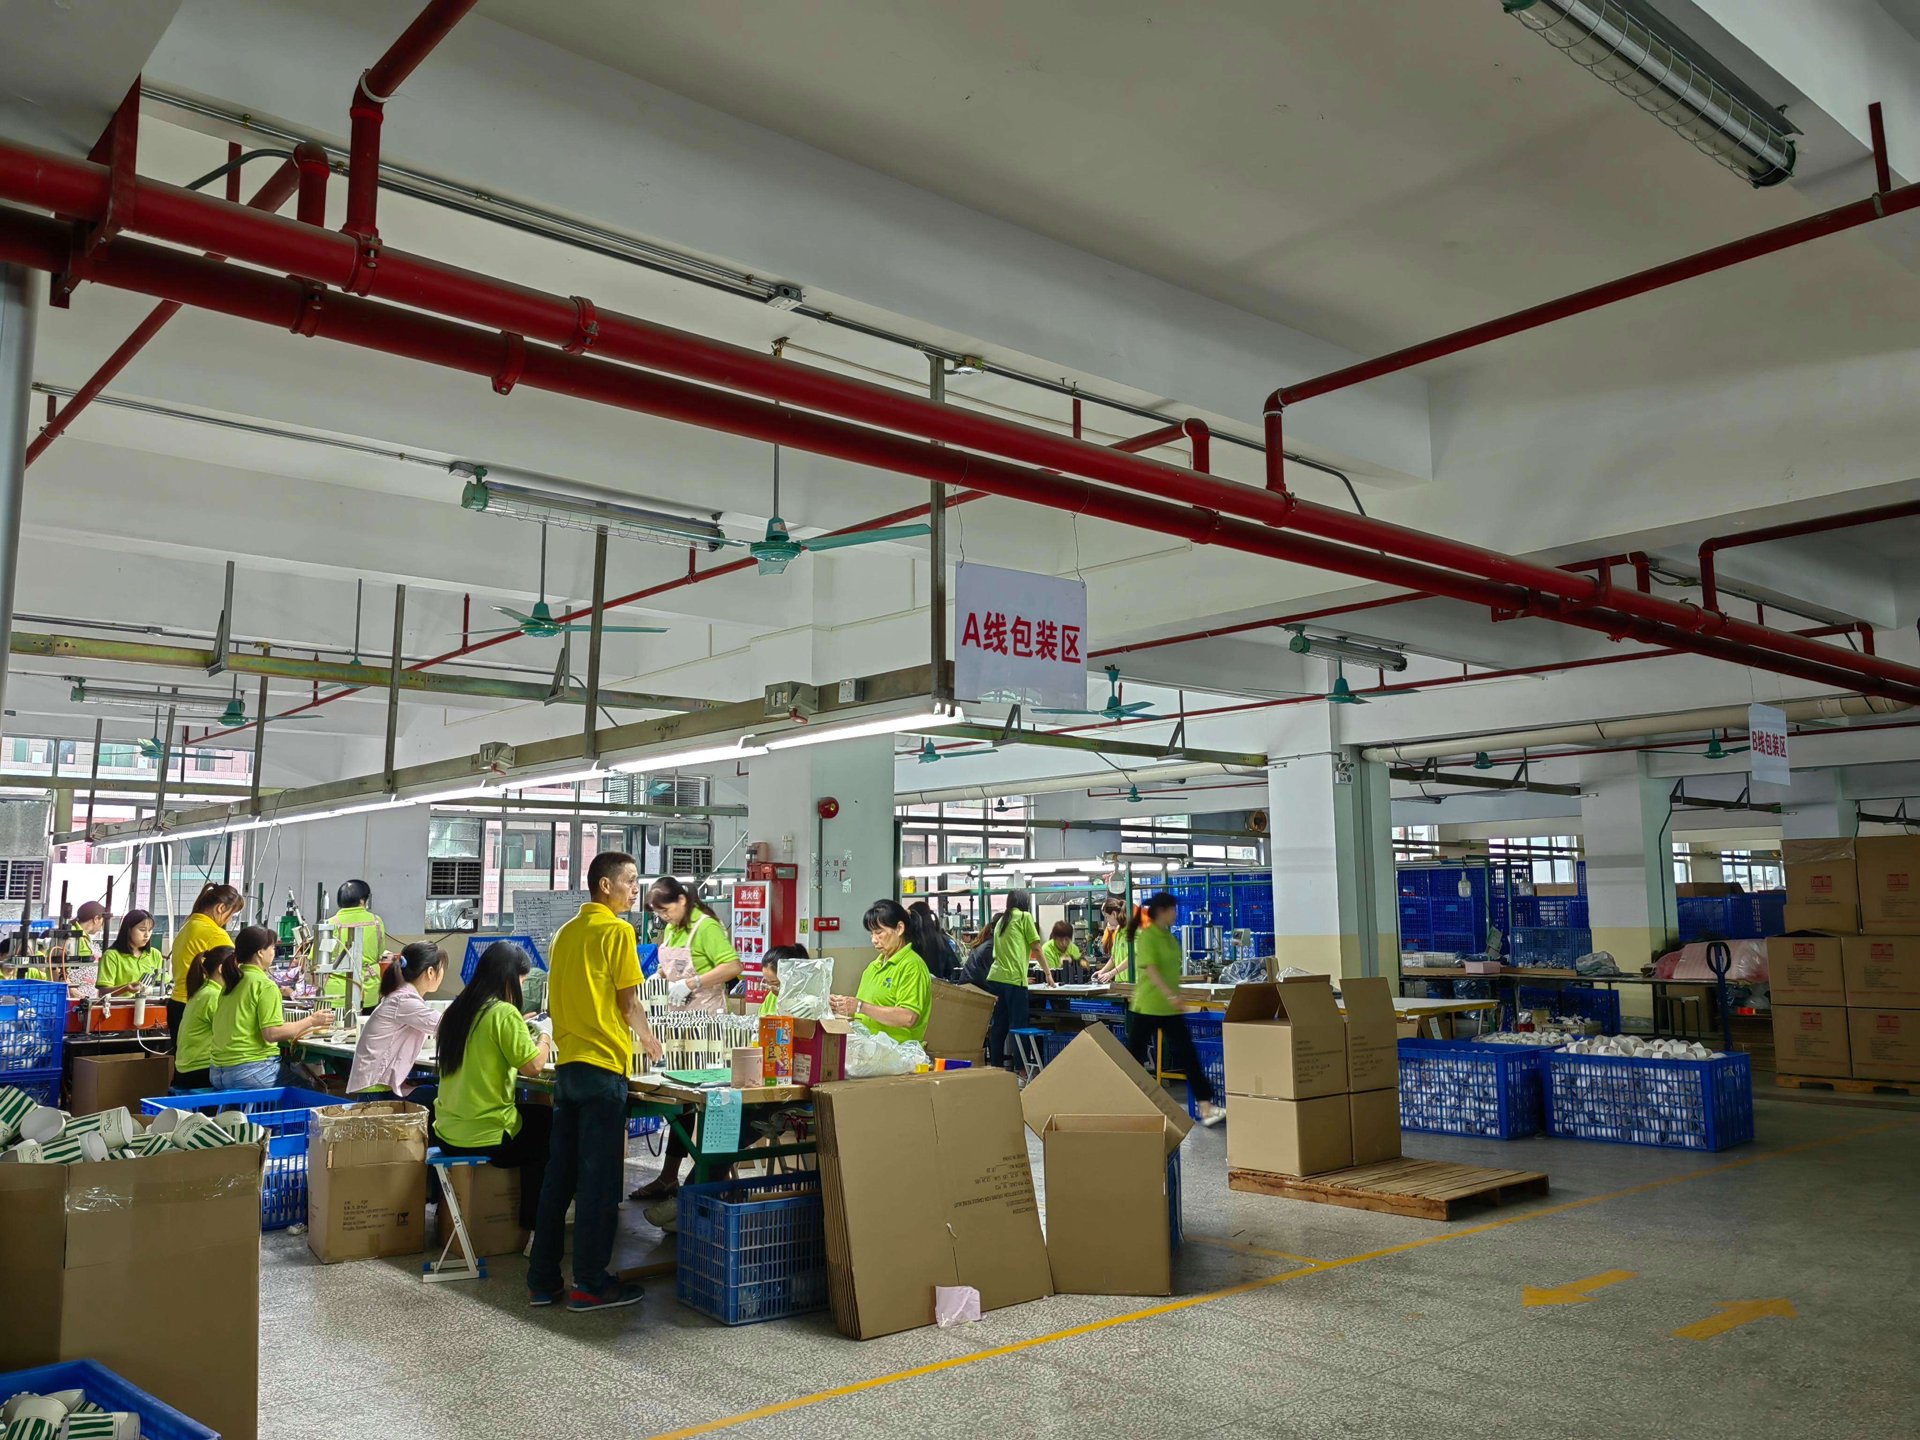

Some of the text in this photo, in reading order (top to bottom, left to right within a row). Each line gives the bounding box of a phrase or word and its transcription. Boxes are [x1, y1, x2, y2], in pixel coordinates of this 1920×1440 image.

[962, 611, 1081, 663] A线包装区
[1752, 730, 1787, 757] B线包装区
